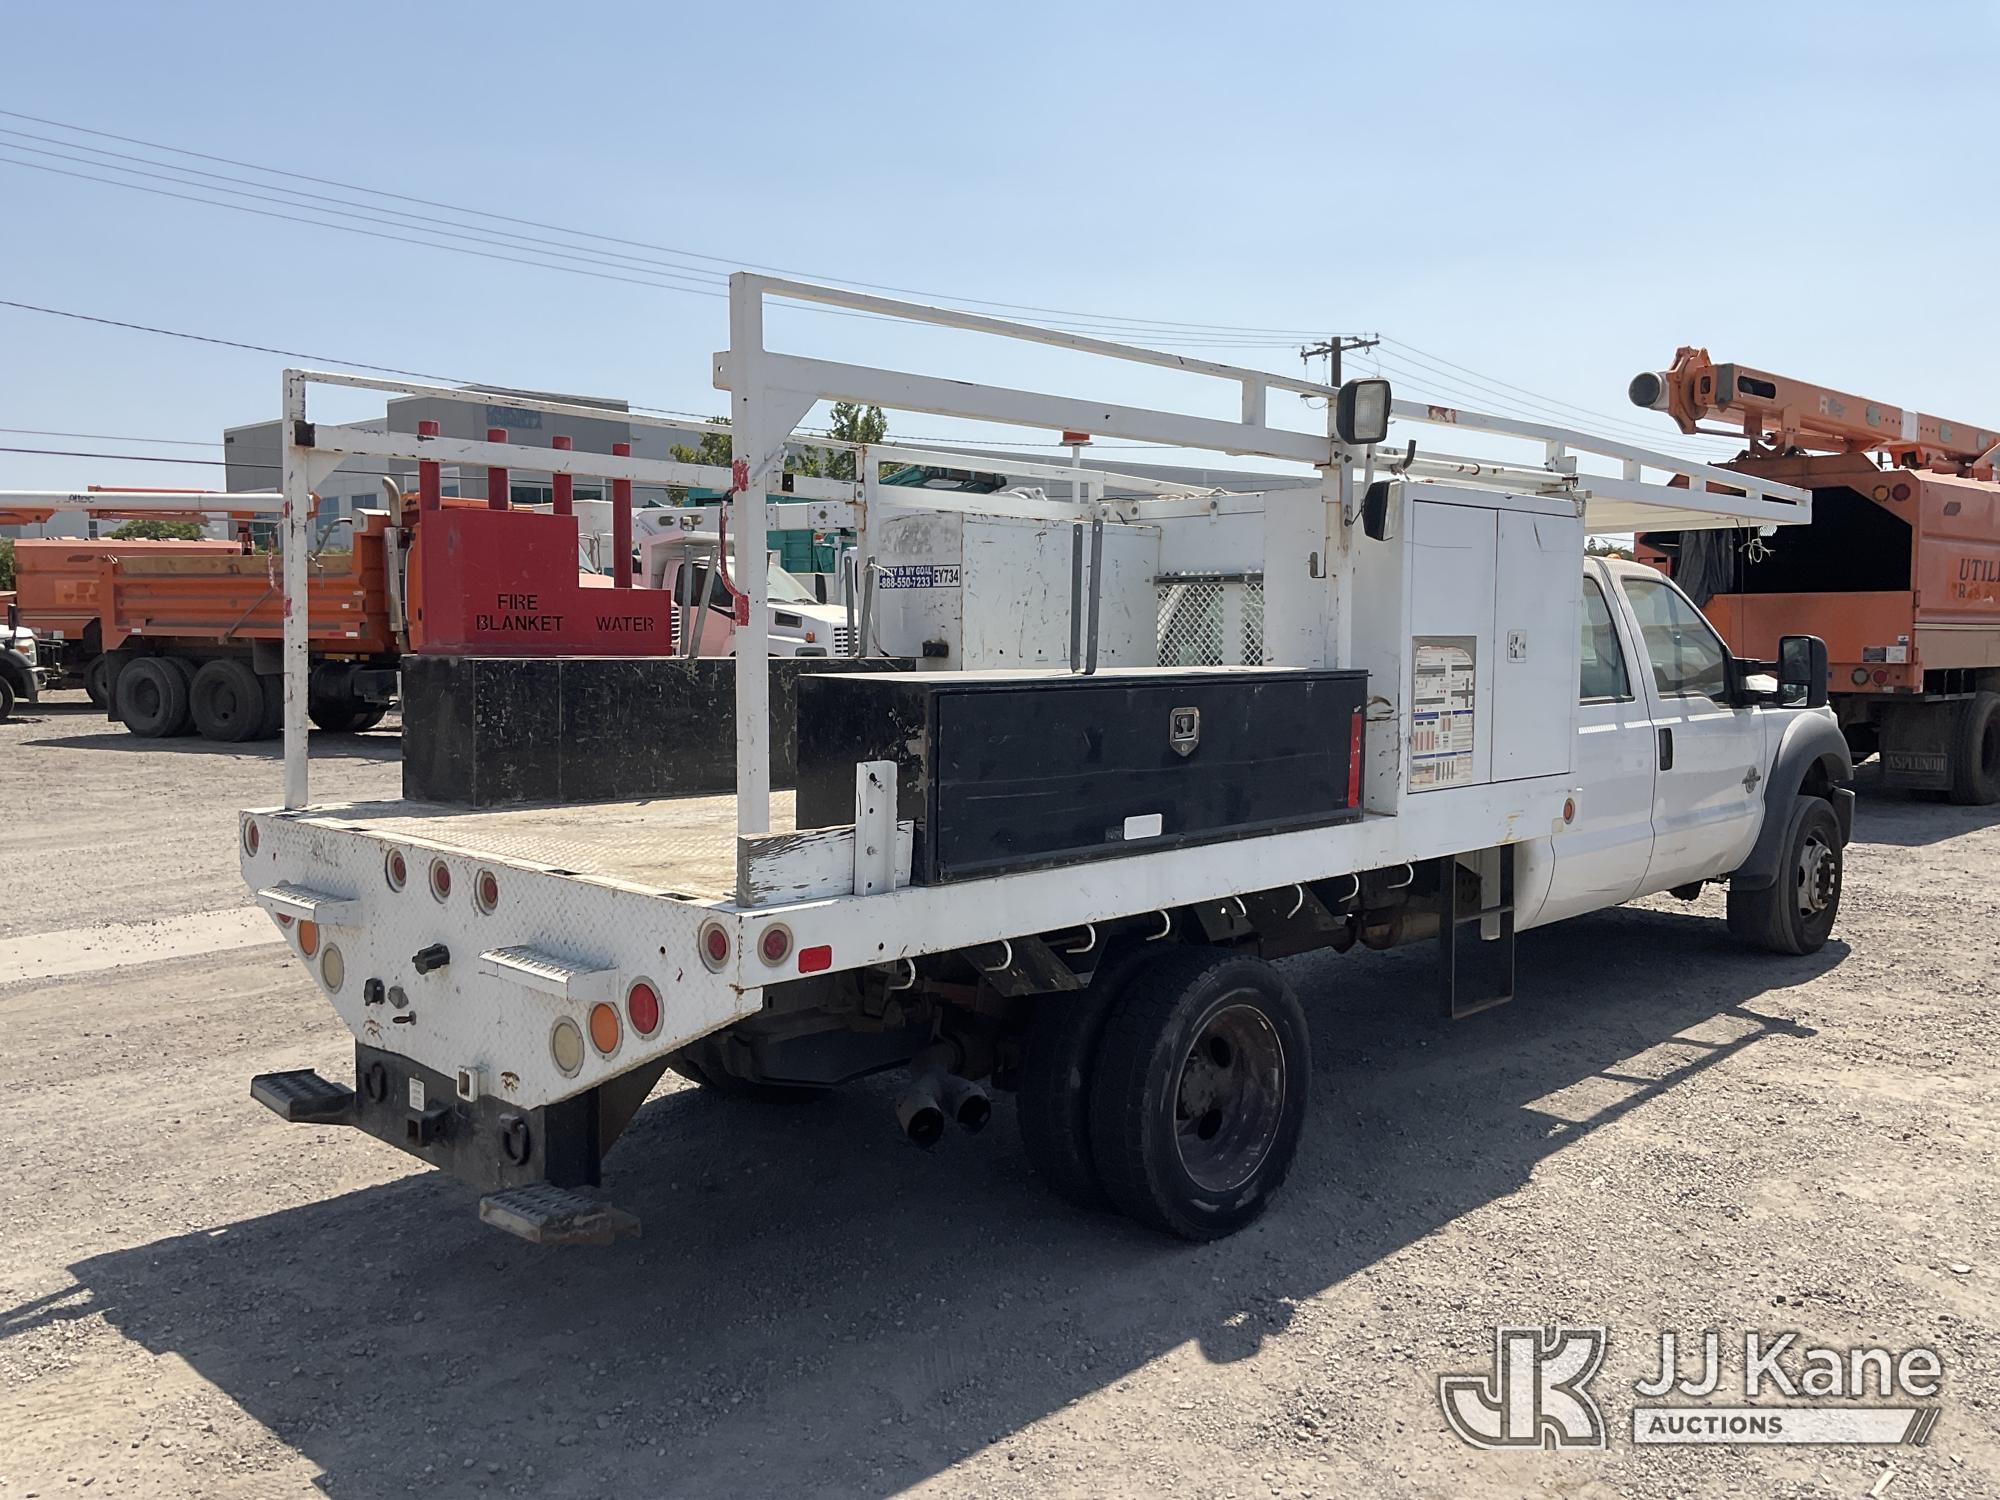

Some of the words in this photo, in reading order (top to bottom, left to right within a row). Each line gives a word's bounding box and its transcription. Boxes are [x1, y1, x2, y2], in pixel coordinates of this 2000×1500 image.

[898, 566, 904, 576] IS
[905, 566, 915, 576] MY
[915, 566, 932, 576] GOAL
[933, 569, 959, 584] EY734
[497, 593, 538, 610] FIRE
[476, 614, 563, 632] BLANKET
[596, 616, 654, 632] WATER
